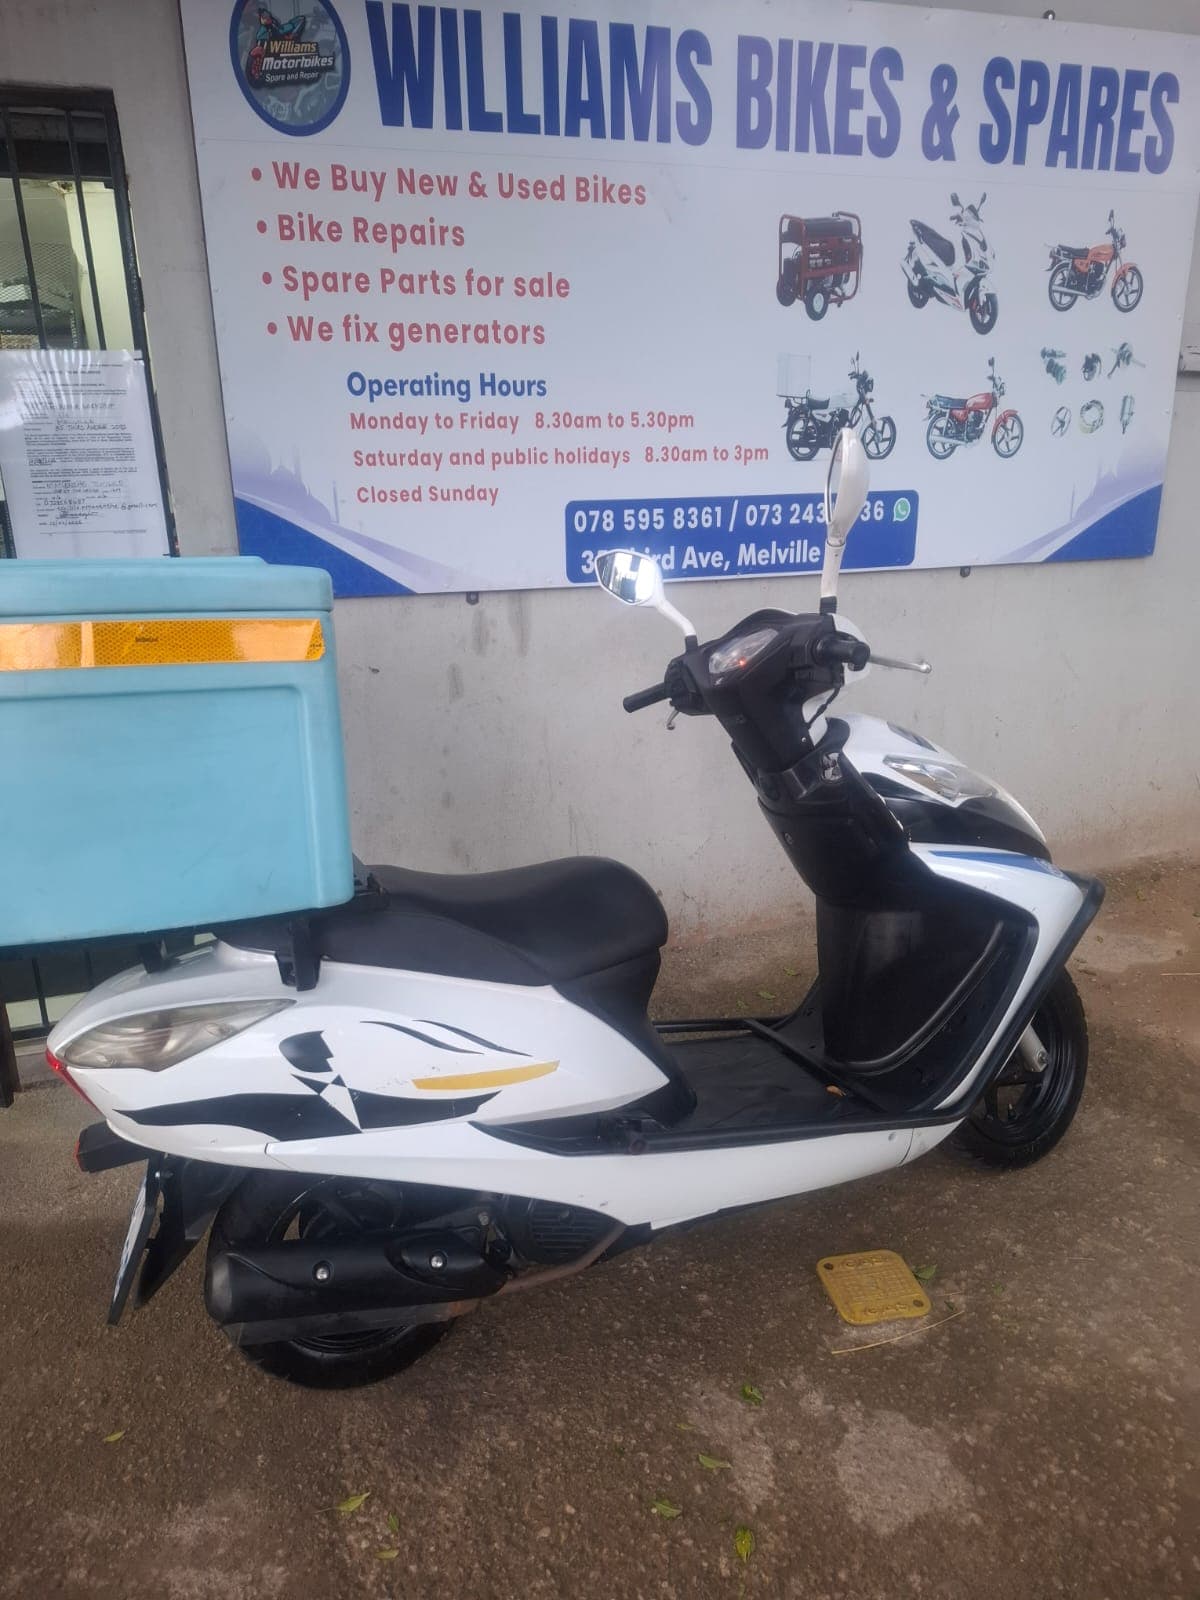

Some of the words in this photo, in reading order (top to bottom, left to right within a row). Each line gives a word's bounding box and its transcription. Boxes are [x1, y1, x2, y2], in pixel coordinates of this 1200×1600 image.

[270, 41, 317, 53] Williams
[262, 57, 333, 70] Motorbikes
[286, 72, 299, 80] and
[299, 71, 319, 79] Repair
[364, 0, 713, 146] WILLIAMS
[735, 34, 904, 159] BIKES
[921, 63, 961, 162] &
[978, 56, 1180, 175] SPARES
[271, 161, 321, 191] We
[330, 163, 387, 203] Buy
[397, 167, 459, 197] New
[468, 171, 489, 198] &
[497, 172, 566, 202] Used
[575, 174, 646, 205] Bikes
[277, 211, 343, 243] Bike
[352, 216, 465, 254] Repairs
[282, 265, 370, 302] Spare
[380, 267, 457, 296] Parts
[465, 268, 505, 297] for
[513, 271, 570, 298] sale
[286, 315, 334, 342] We
[342, 313, 379, 343] fix
[388, 319, 546, 352] generators
[346, 371, 471, 403] Operating
[479, 372, 547, 397] Hours
[349, 411, 429, 436] Monday
[434, 412, 454, 430] to
[459, 410, 519, 435] Friday
[535, 411, 602, 429] 8.30am
[607, 412, 625, 429] to
[630, 411, 694, 433] 5.30pm
[353, 448, 443, 472] Saturday
[449, 448, 485, 466] and
[491, 446, 549, 471] public
[554, 445, 630, 469] holidays
[644, 445, 708, 463] 8.30am
[712, 446, 729, 462] to
[734, 444, 769, 466] 3pm
[356, 485, 423, 504] Closed
[428, 484, 499, 507] Sunday
[574, 509, 615, 533] 078
[623, 508, 665, 531] 595
[673, 506, 722, 530] 8361
[728, 499, 739, 532] /
[745, 503, 782, 527] 073
[789, 502, 825, 524] 243
[681, 545, 731, 572] Ave,
[737, 539, 821, 567] Melville
